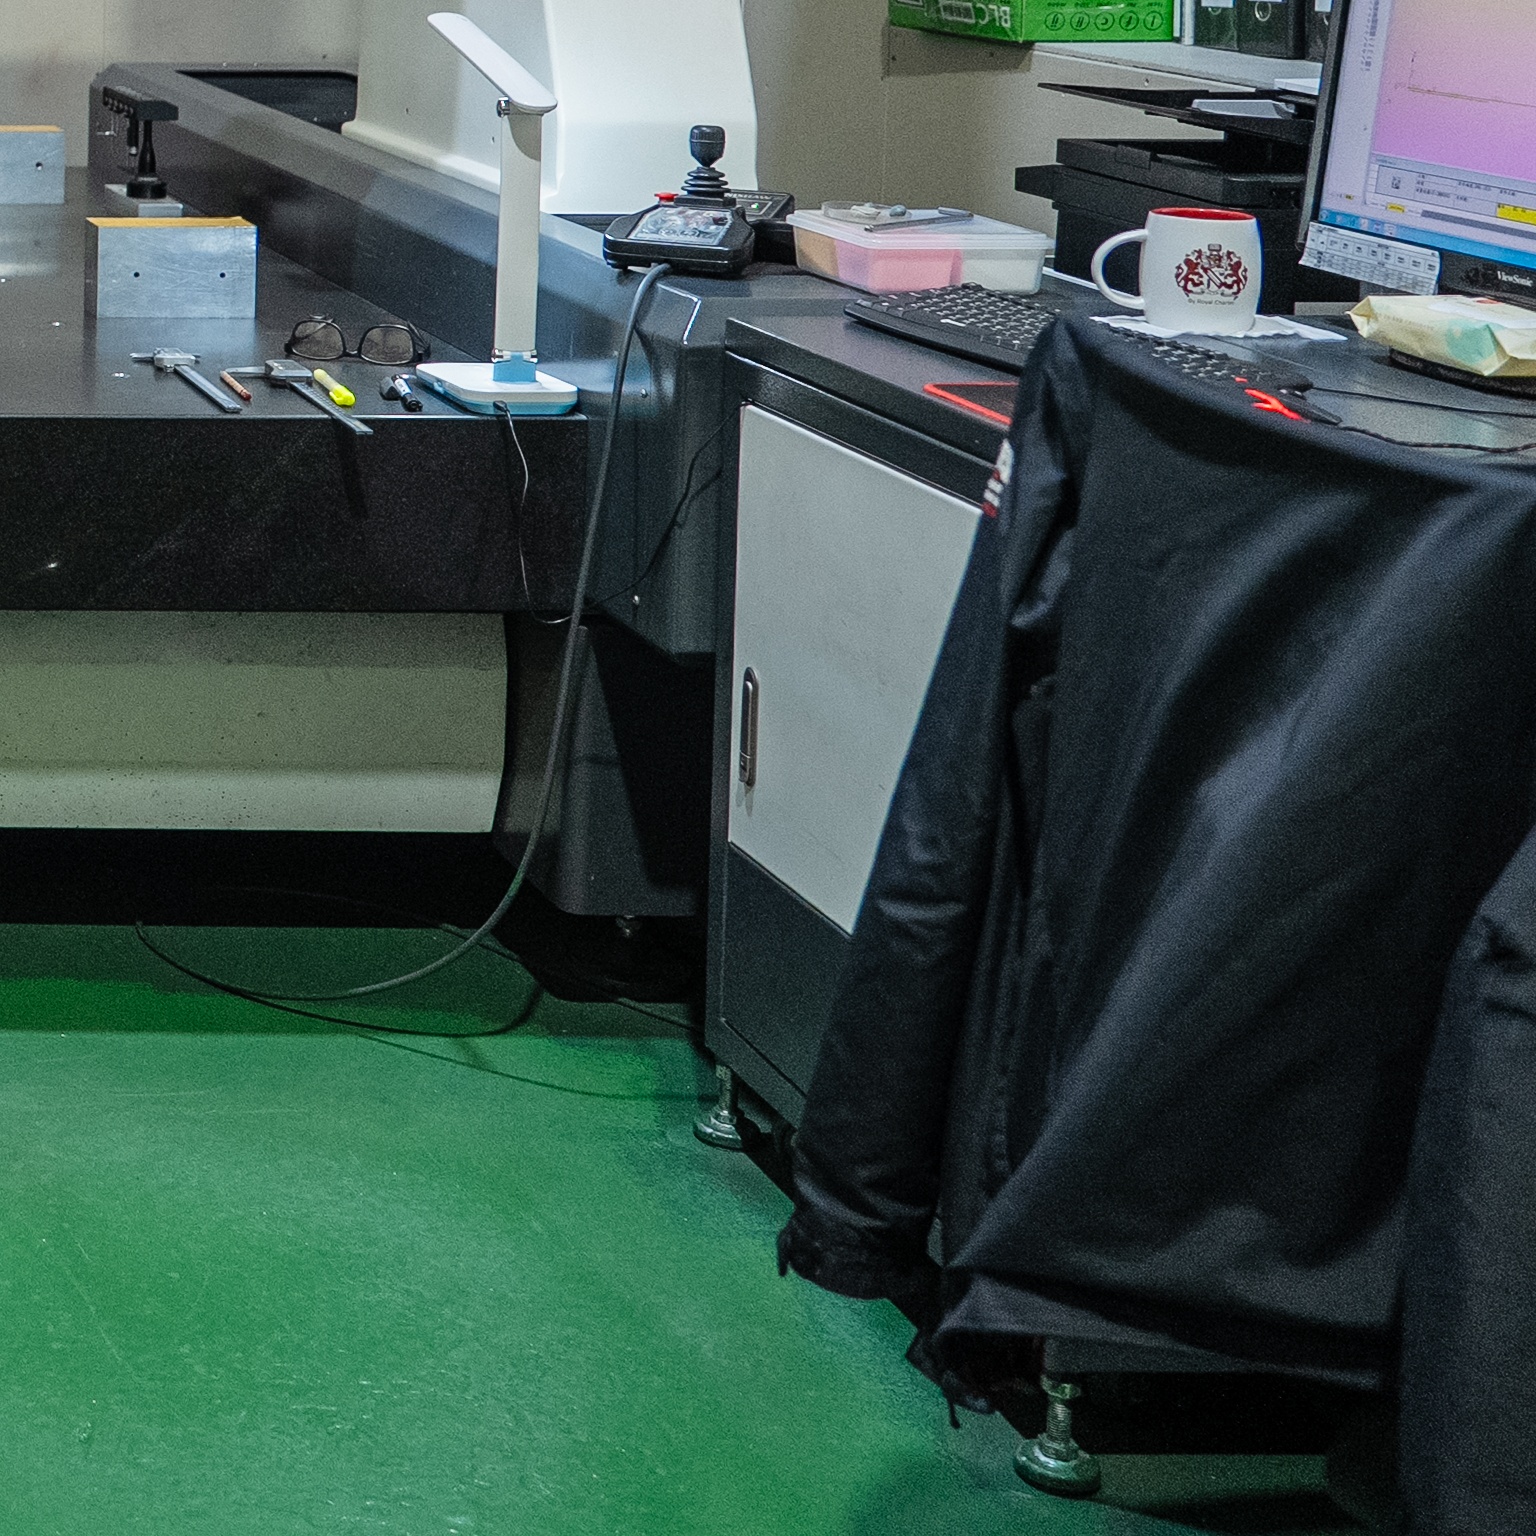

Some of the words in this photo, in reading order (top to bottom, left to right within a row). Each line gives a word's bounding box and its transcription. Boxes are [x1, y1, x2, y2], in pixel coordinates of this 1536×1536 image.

[974, 2, 1012, 29] BLC
[724, 192, 772, 200] NISHAW
[1497, 270, 1533, 287] ViewSonic
